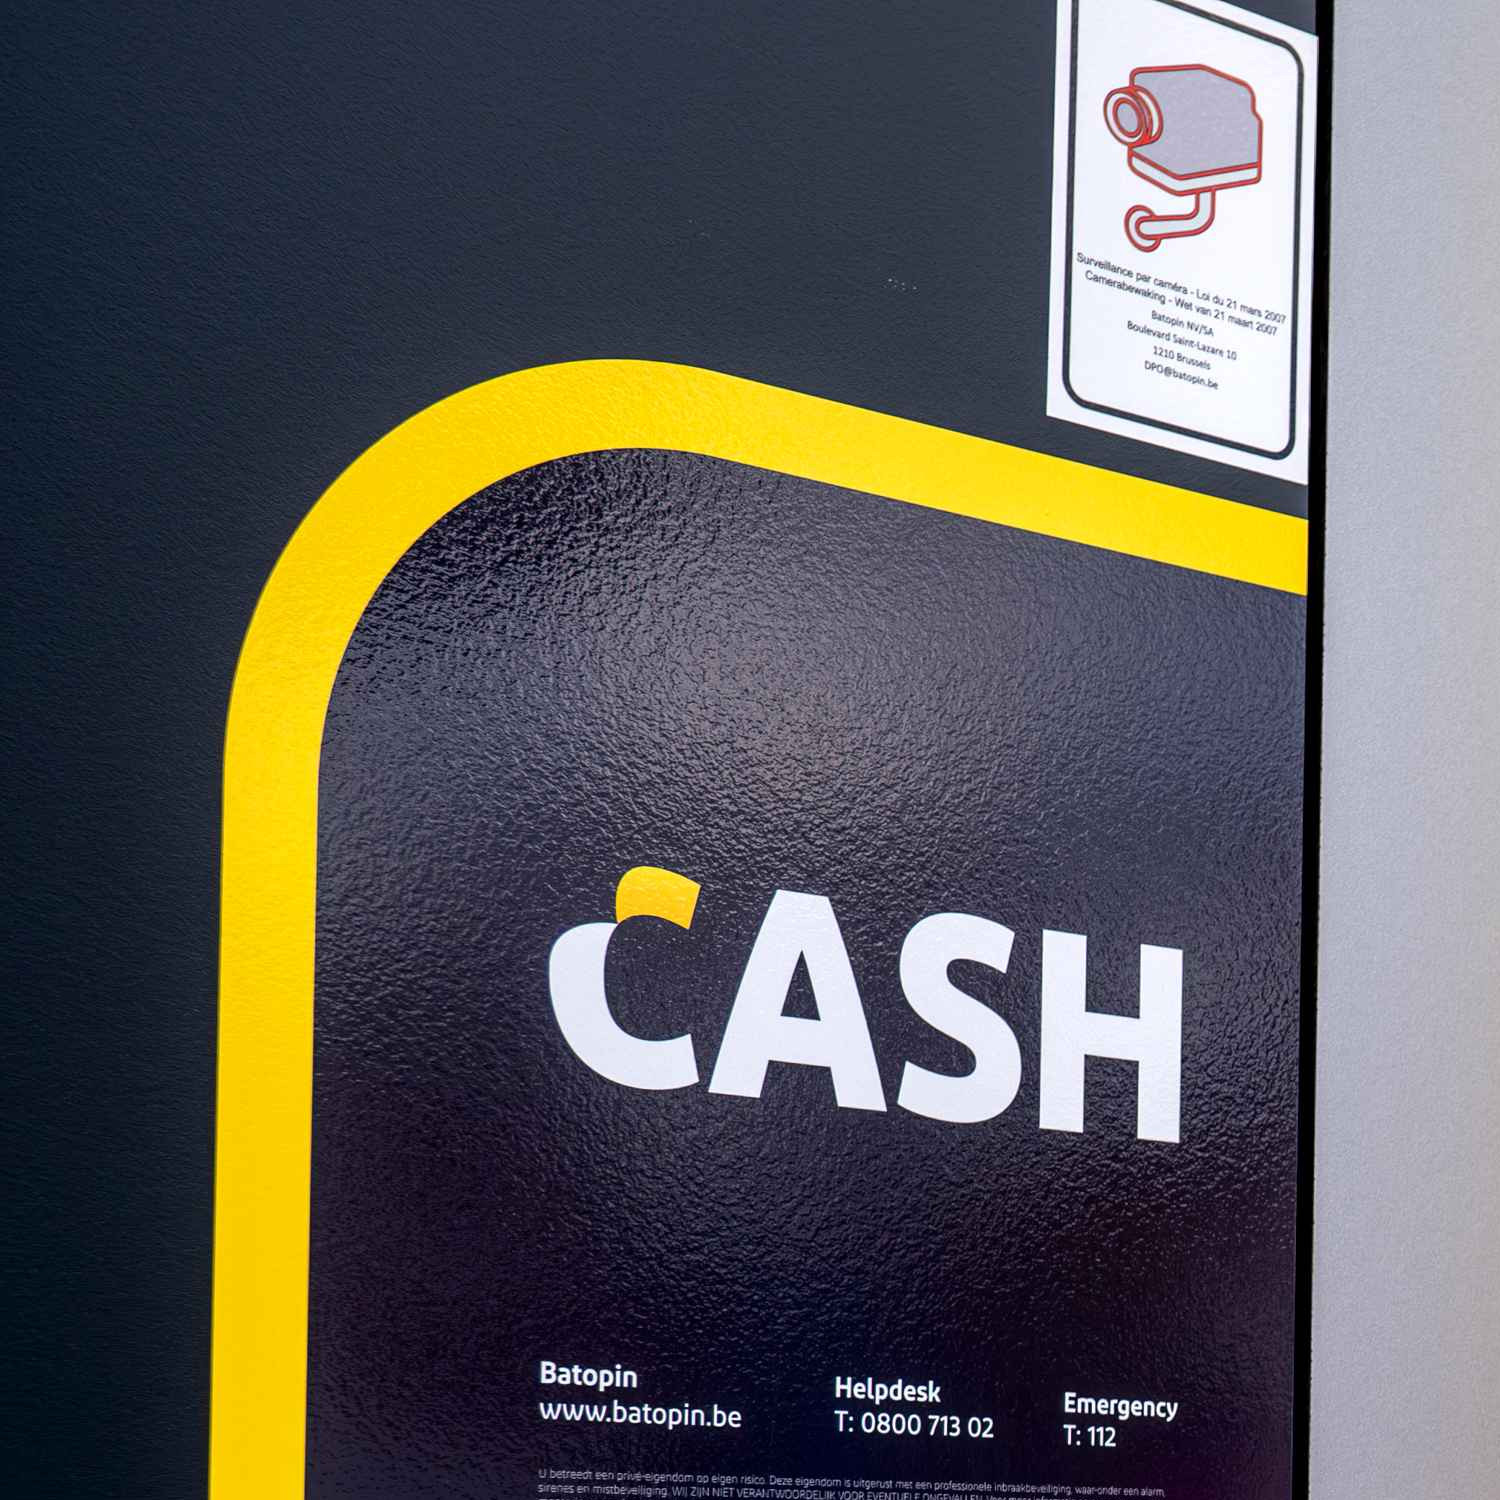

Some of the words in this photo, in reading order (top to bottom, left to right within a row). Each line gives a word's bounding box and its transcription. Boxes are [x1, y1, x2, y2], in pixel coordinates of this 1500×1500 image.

[1076, 252, 1133, 278] Surveillance
[1136, 272, 1152, 282] par
[1196, 289, 1210, 302] Loi
[1212, 295, 1224, 306] du
[1226, 298, 1237, 310] 21
[1240, 304, 1262, 317] mars
[1264, 309, 1286, 324] 2007
[1085, 270, 1166, 305] Camerabewaking
[1174, 297, 1193, 311] Wet
[1195, 305, 1212, 317] van
[1213, 309, 1225, 320] 21
[1256, 321, 1277, 336] 2007
[1152, 310, 1184, 328] Batopin
[1187, 320, 1214, 336] NV/SA
[1127, 320, 1171, 341] Boulevard
[1173, 334, 1224, 358] Saint-Lazare
[1226, 349, 1237, 361] 10
[1153, 345, 1175, 360] 1210
[1176, 353, 1211, 370] Brussels
[1144, 360, 1219, 390] DPO@batopin.be
[548, 865, 1184, 1144] CASH
[540, 1361, 638, 1392] Batopin
[834, 1376, 942, 1405] Helpdesk
[539, 1400, 743, 1430] www.batopin.be
[1063, 1392, 1179, 1422] Emergency
[834, 1410, 854, 1433] T:
[861, 1412, 922, 1435] 0800
[928, 1415, 961, 1437] 713
[967, 1417, 995, 1439] 02
[1063, 1424, 1082, 1447] T:
[1086, 1427, 1117, 1448] 112
[549, 1468, 592, 1480] betreedt
[711, 1472, 738, 1487] eigen
[768, 1474, 792, 1486] Deze
[794, 1475, 841, 1489] eigendom
[852, 1476, 892, 1491] uitgerust
[934, 1479, 991, 1493] professionele
[690, 1486, 709, 1497] ZIJN
[712, 1486, 733, 1498] NIET
[736, 1487, 835, 1500] VERANTWOORDELIJK
[837, 1489, 864, 1500] VOOR
